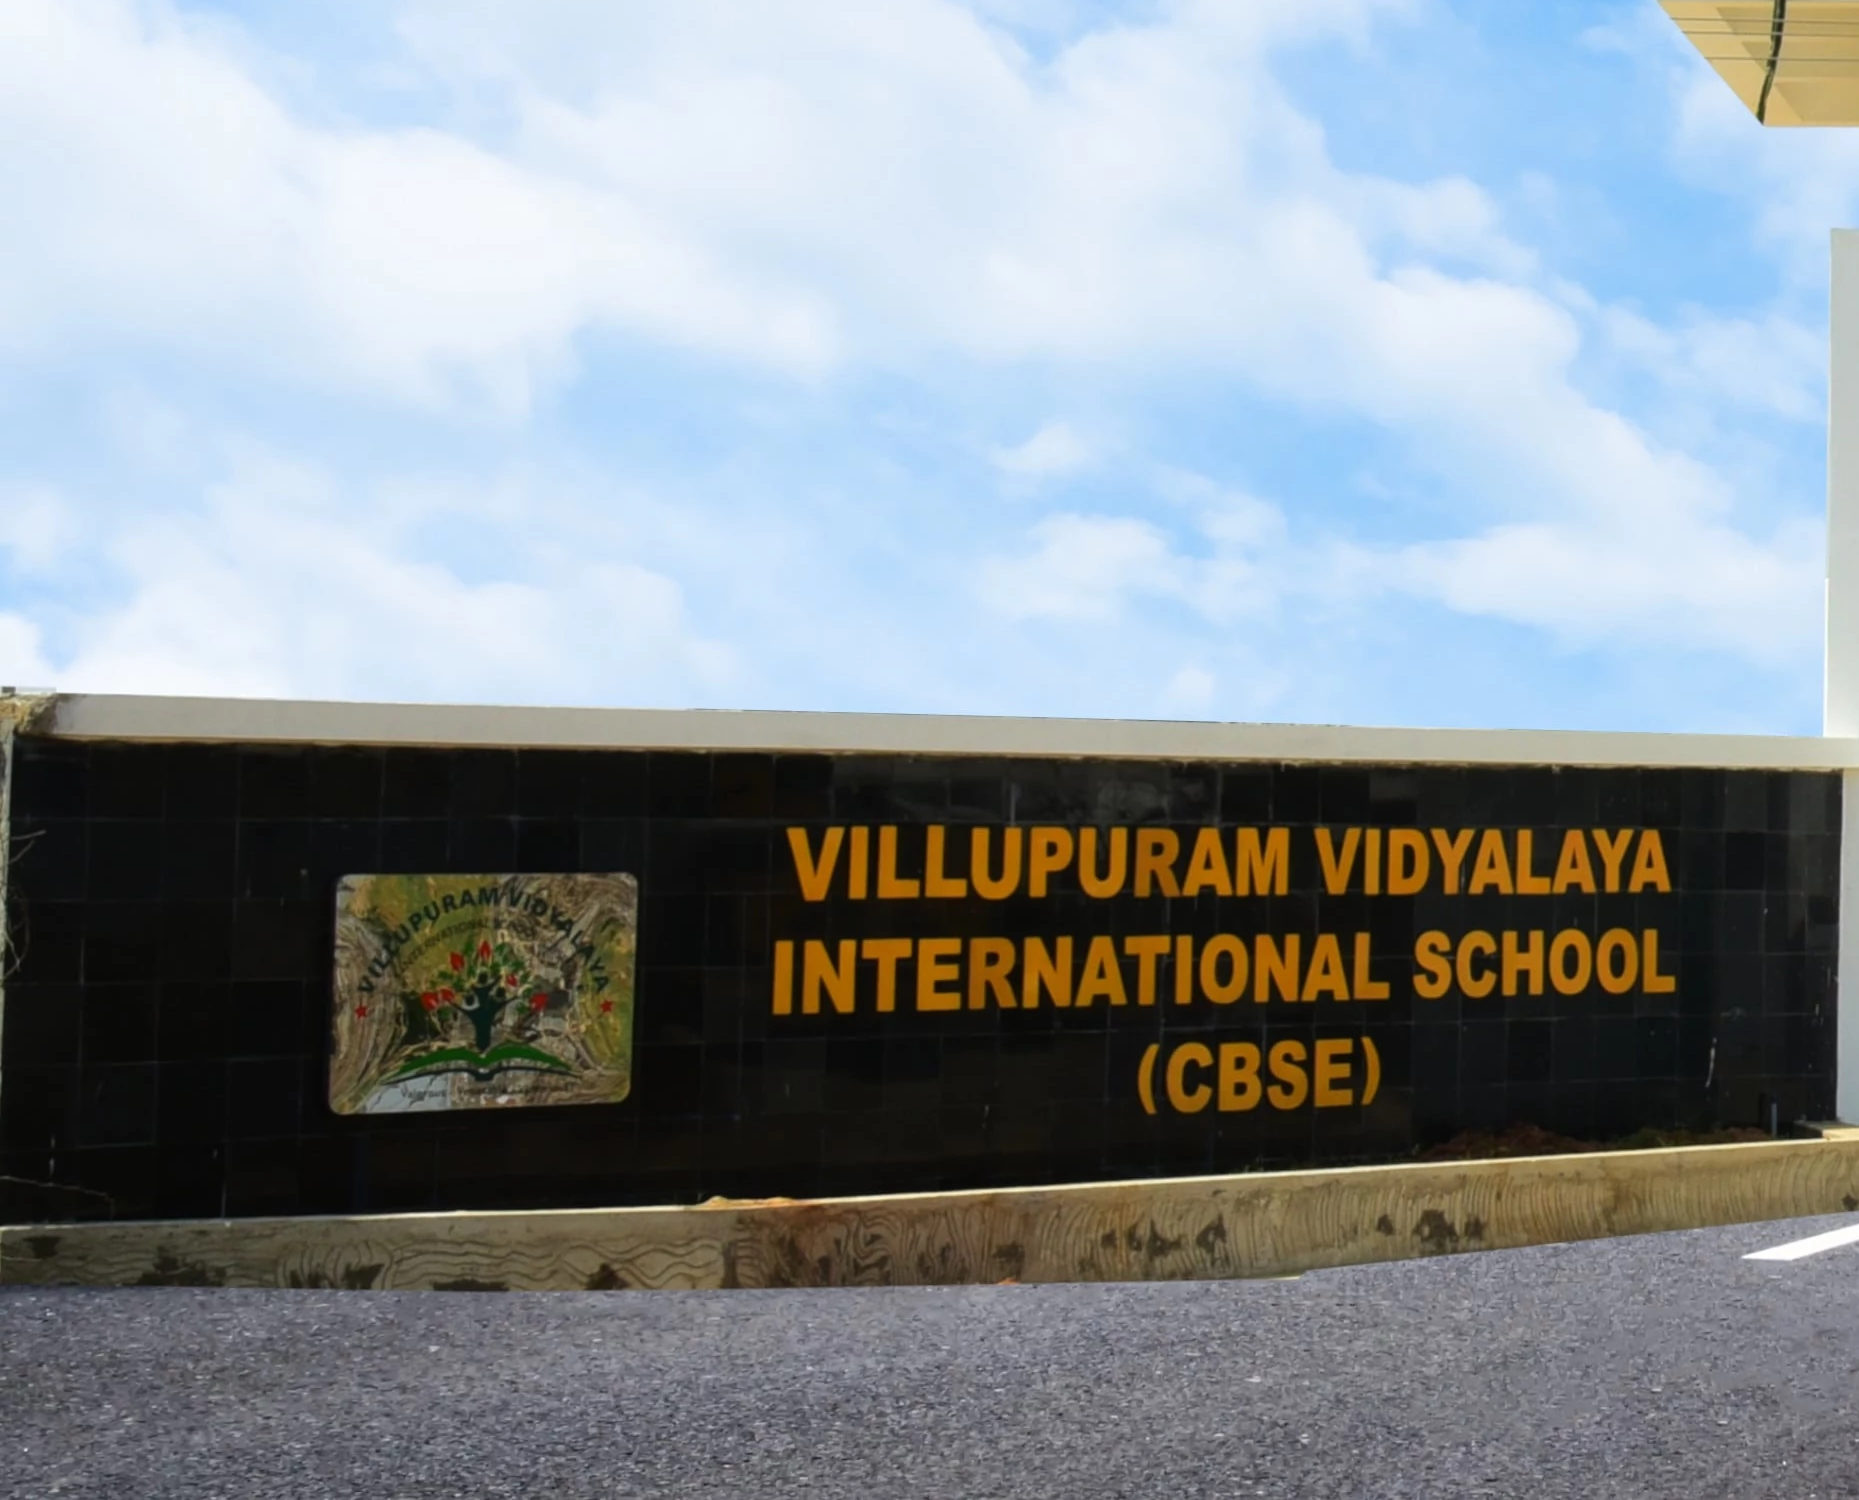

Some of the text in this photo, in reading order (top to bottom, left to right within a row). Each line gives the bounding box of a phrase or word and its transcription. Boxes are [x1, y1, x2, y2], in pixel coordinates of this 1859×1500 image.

[787, 824, 1672, 902] VILLUPURAM VIDYALAYA
[772, 928, 1676, 1016] INTERNATIONAL SCHOOL
[1137, 1036, 1382, 1115] (CBSE)
